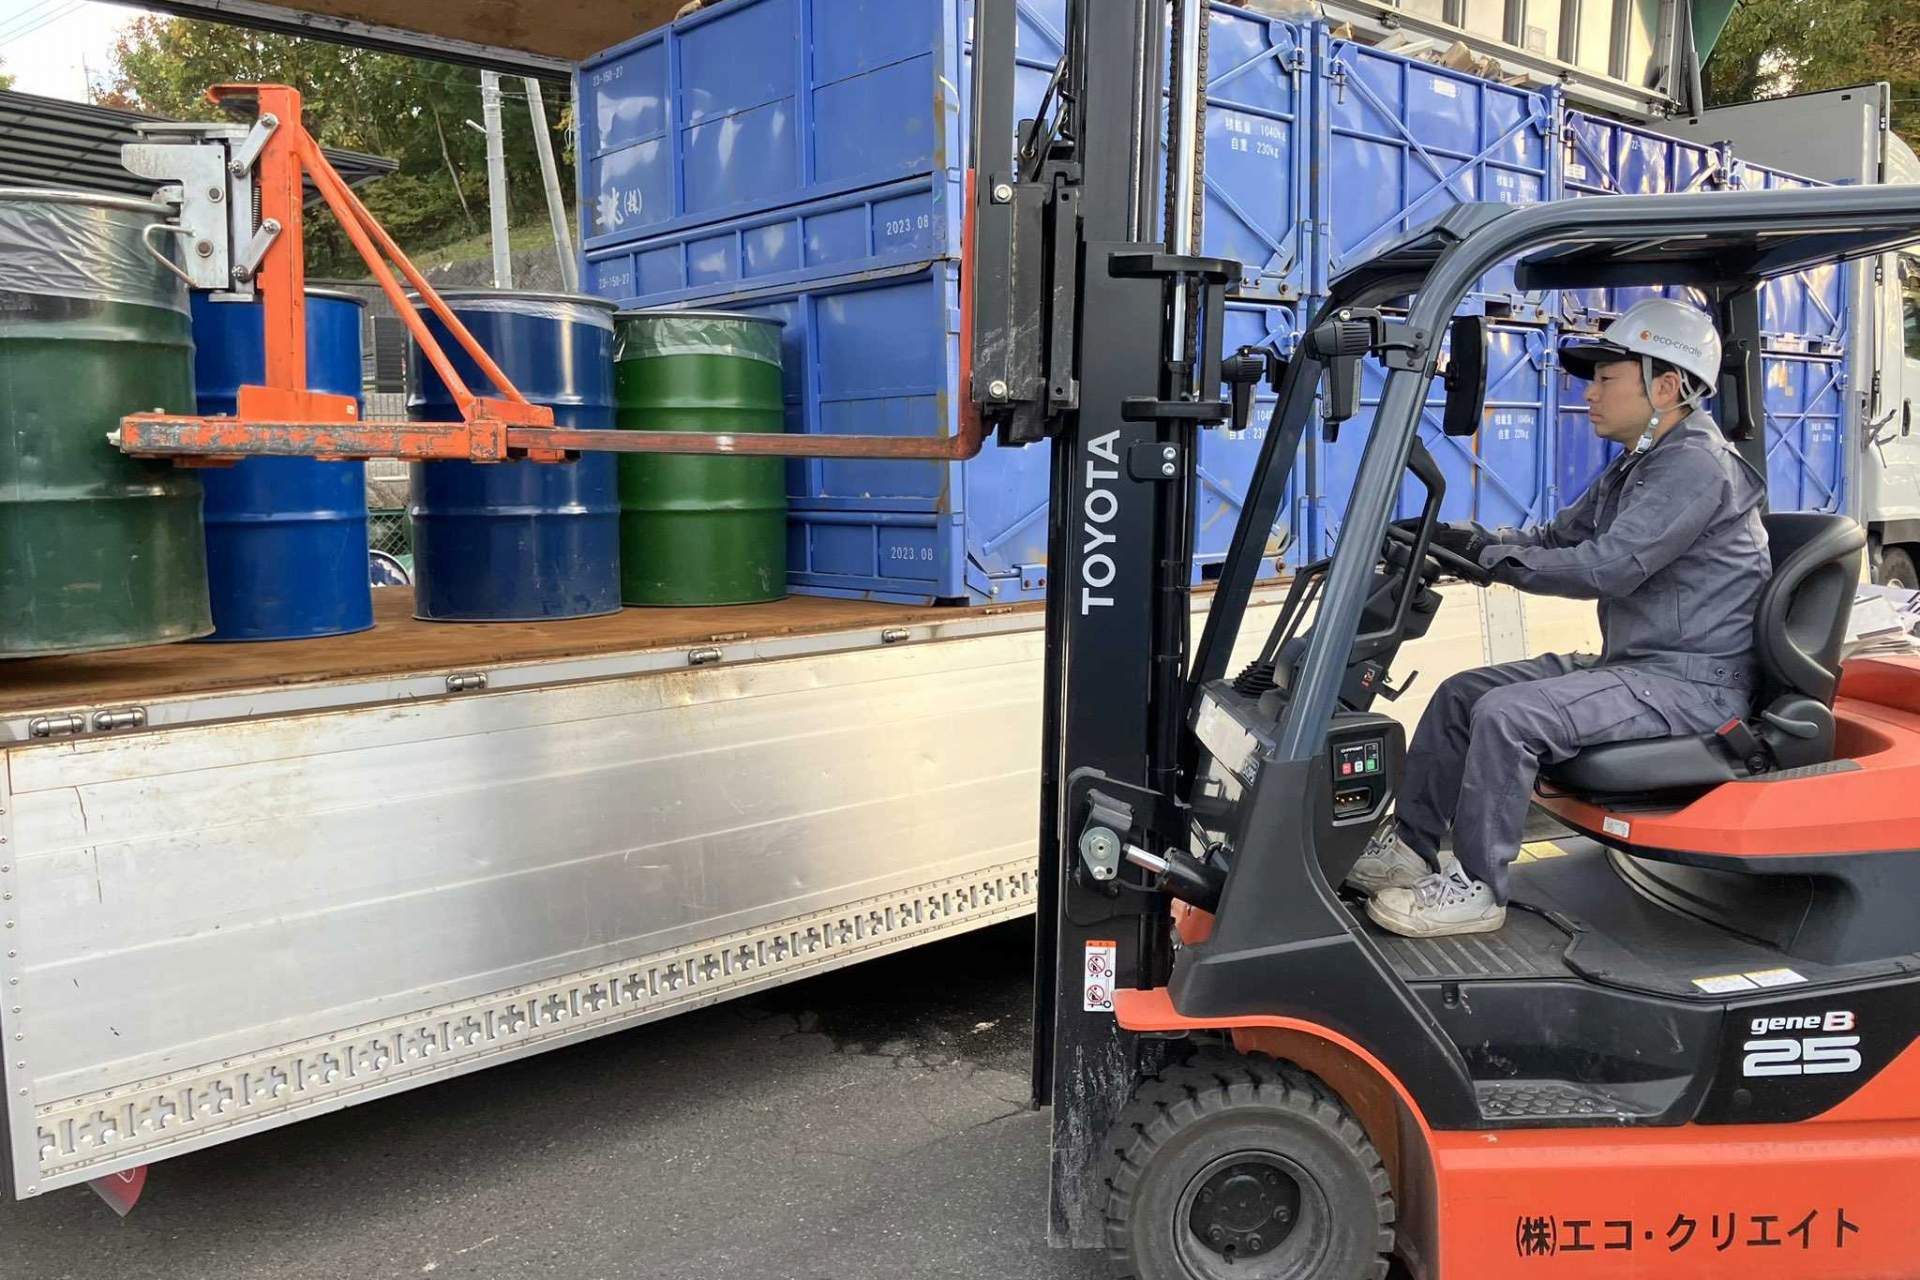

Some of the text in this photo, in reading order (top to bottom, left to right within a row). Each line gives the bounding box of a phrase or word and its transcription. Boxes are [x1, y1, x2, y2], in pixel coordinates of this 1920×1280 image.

[1081, 429, 1121, 615] TOYOTA
[891, 546, 933, 561] 2023.08
[1743, 1036, 1861, 1077] 25
[1516, 1207, 1860, 1257] (株)エコ・クリエイト
